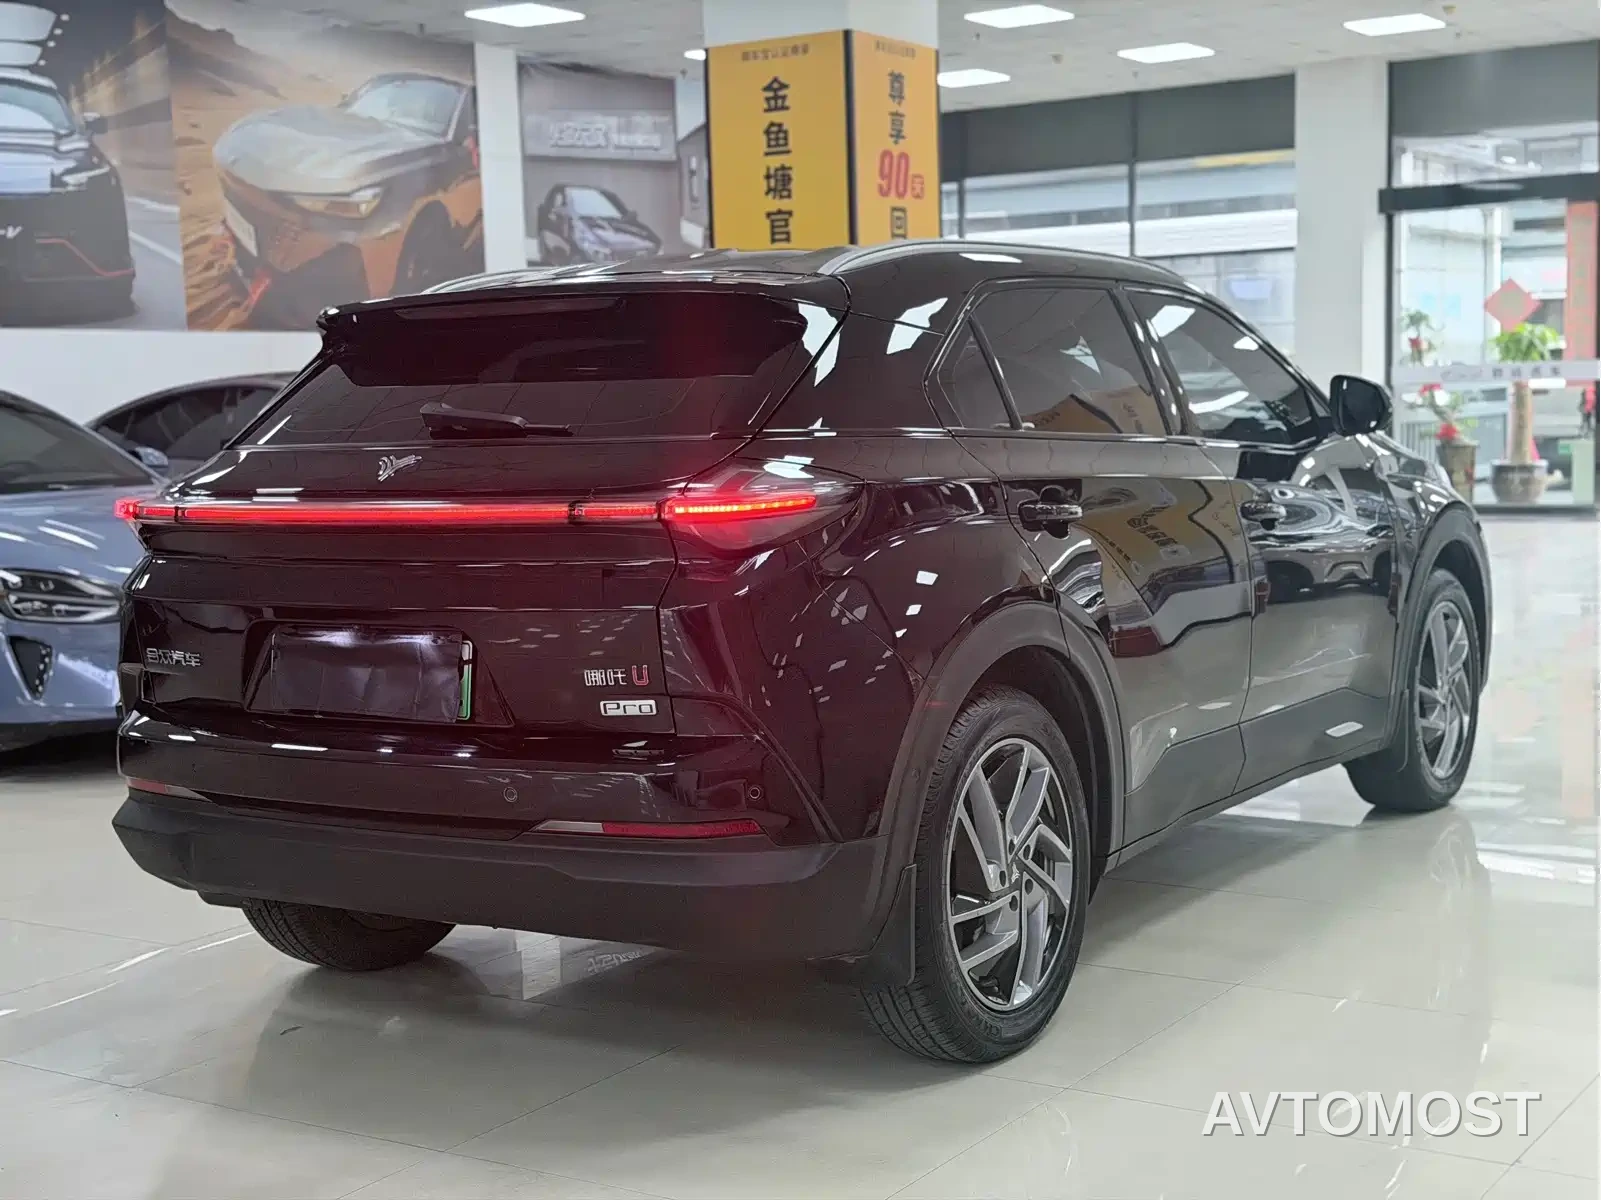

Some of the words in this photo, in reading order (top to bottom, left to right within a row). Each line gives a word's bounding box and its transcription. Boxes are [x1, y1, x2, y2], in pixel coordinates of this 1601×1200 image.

[761, 76, 794, 244] 金鱼塘官
[631, 664, 649, 686] U
[602, 702, 654, 714] Pro
